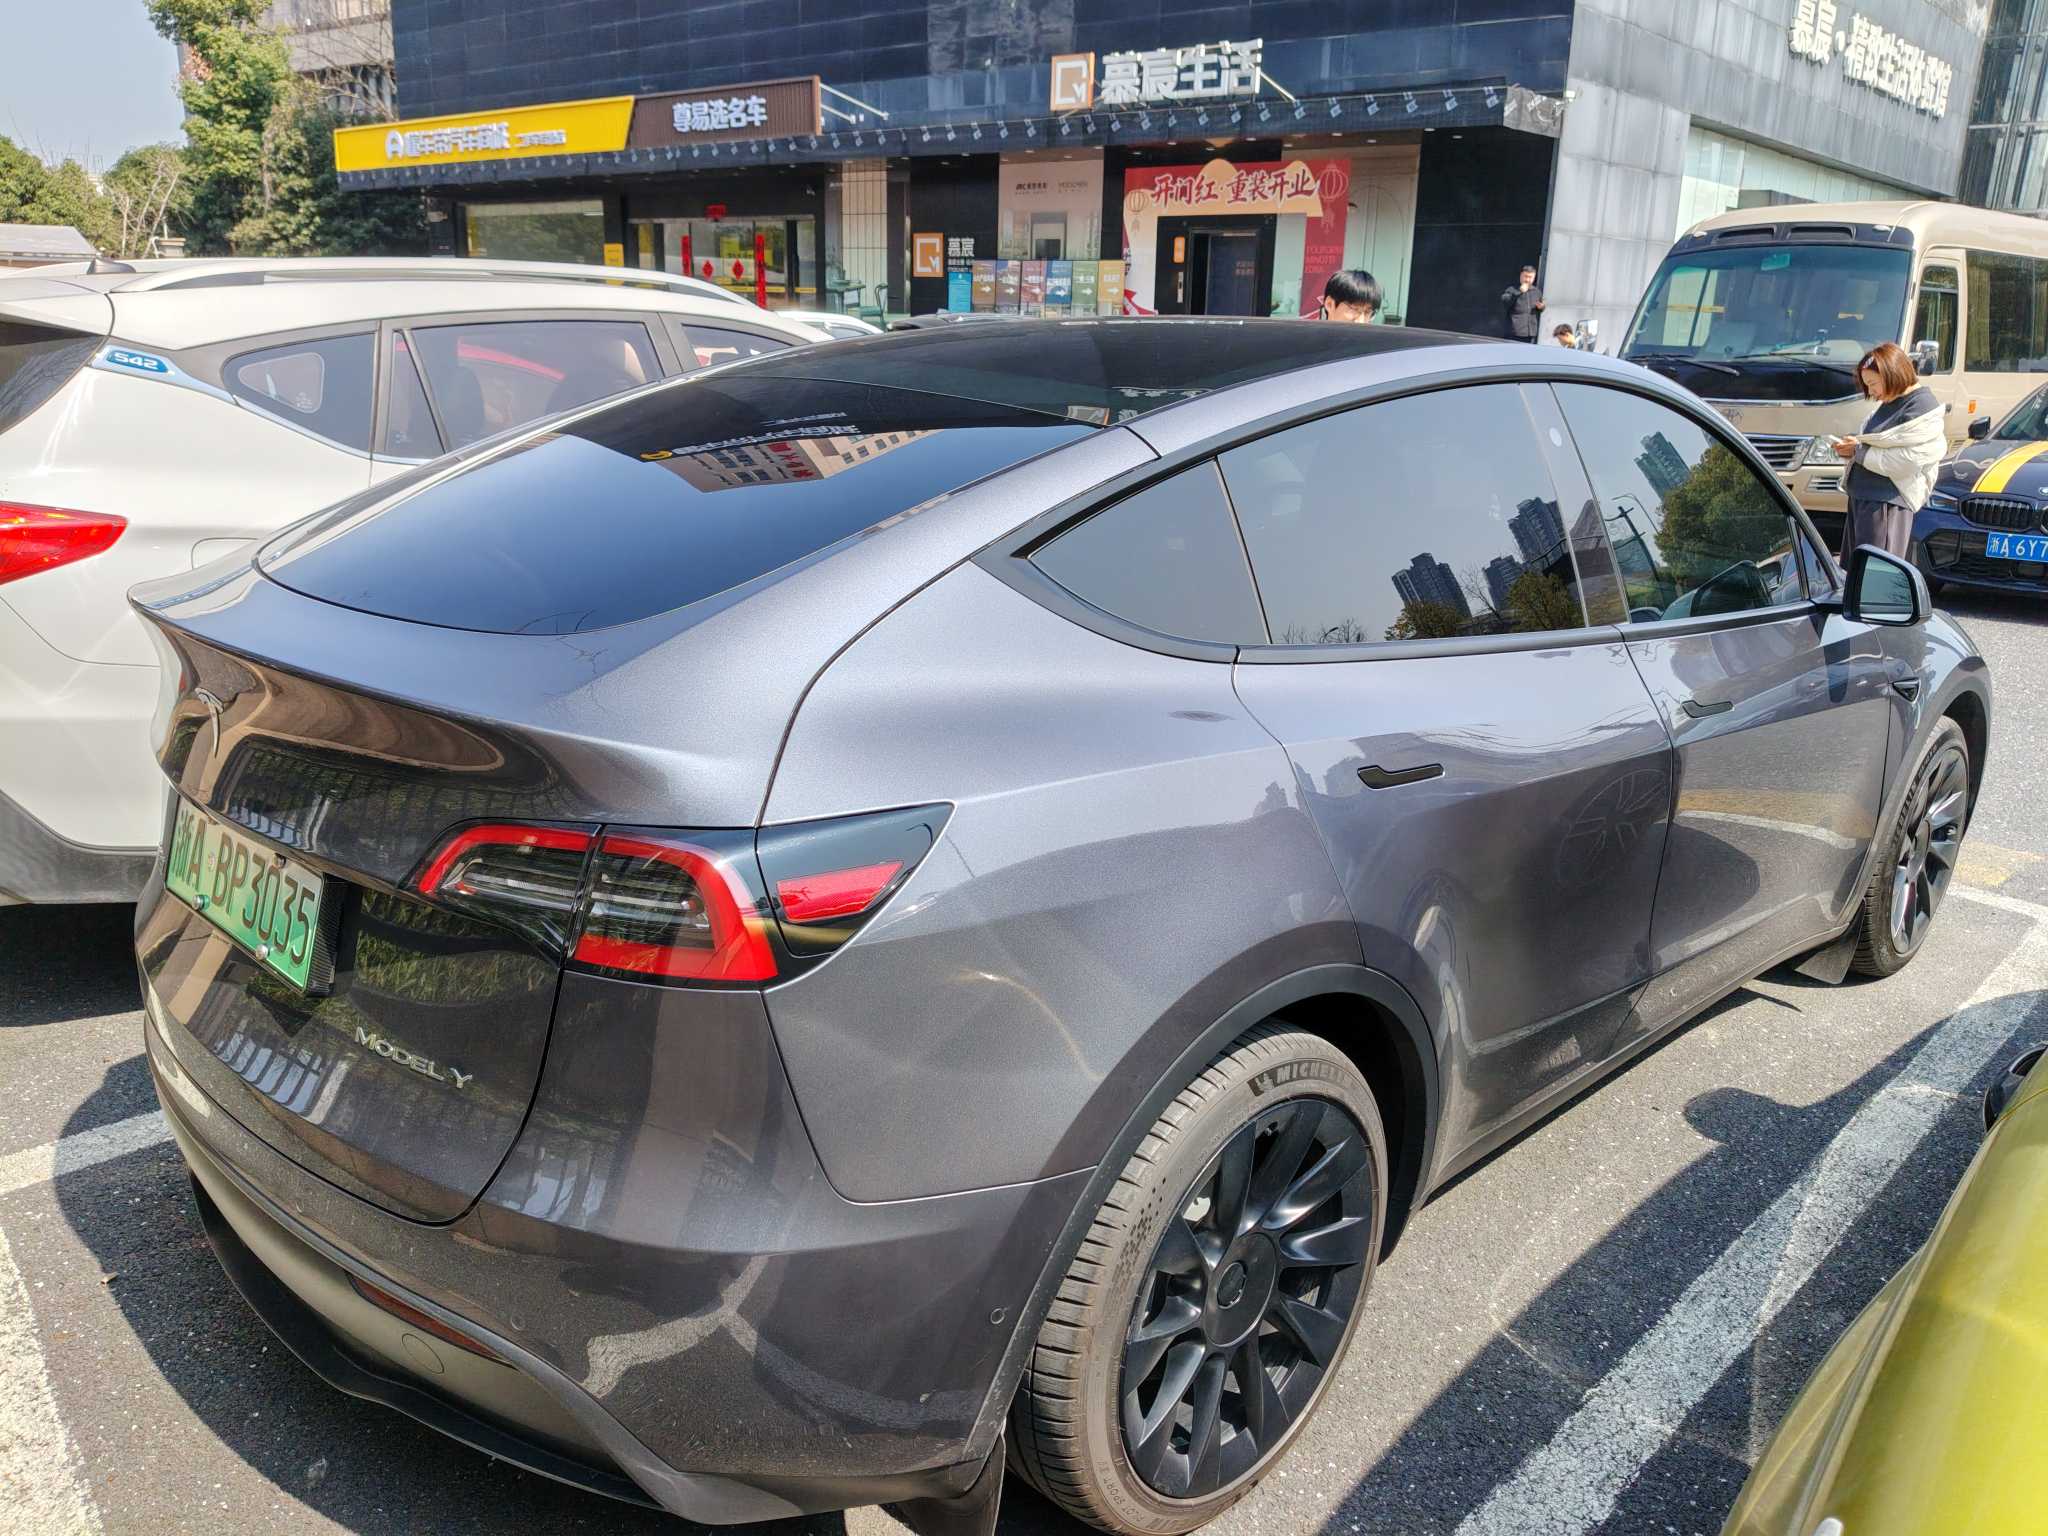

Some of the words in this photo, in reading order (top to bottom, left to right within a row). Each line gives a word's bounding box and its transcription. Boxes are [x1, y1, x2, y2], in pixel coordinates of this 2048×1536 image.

[672, 95, 768, 133] 尊易选名车
[113, 351, 160, 370] S42
[354, 1026, 445, 1082] MODEL
[449, 1067, 473, 1090] Y
[1276, 1062, 1350, 1090] MICHELI
